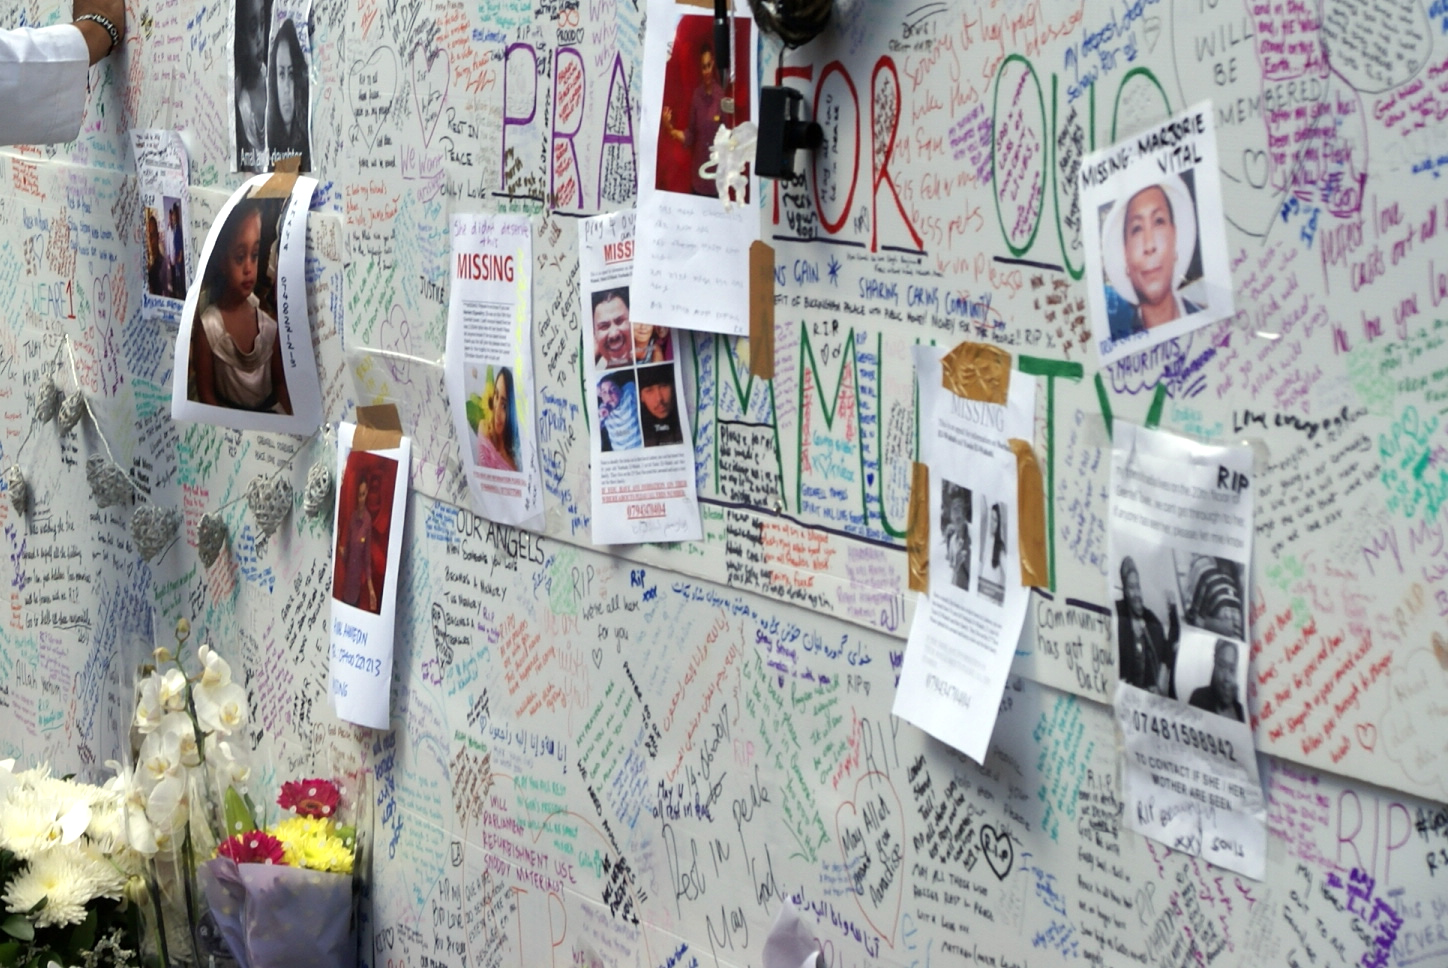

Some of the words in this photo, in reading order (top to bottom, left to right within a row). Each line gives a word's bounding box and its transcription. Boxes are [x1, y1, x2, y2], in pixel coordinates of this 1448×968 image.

[1194, 24, 1255, 63] WILL
[1213, 61, 1239, 87] BE
[1157, 142, 1203, 175] VITAL
[456, 253, 514, 283] MISSING
[1217, 464, 1250, 494] RIP
[456, 507, 482, 542] OUR
[485, 521, 545, 566] ANGELS
[571, 565, 596, 601] RIP
[482, 808, 525, 836] PARLIAMENT
[1336, 788, 1412, 885] RIP
[554, 861, 577, 885] USE
